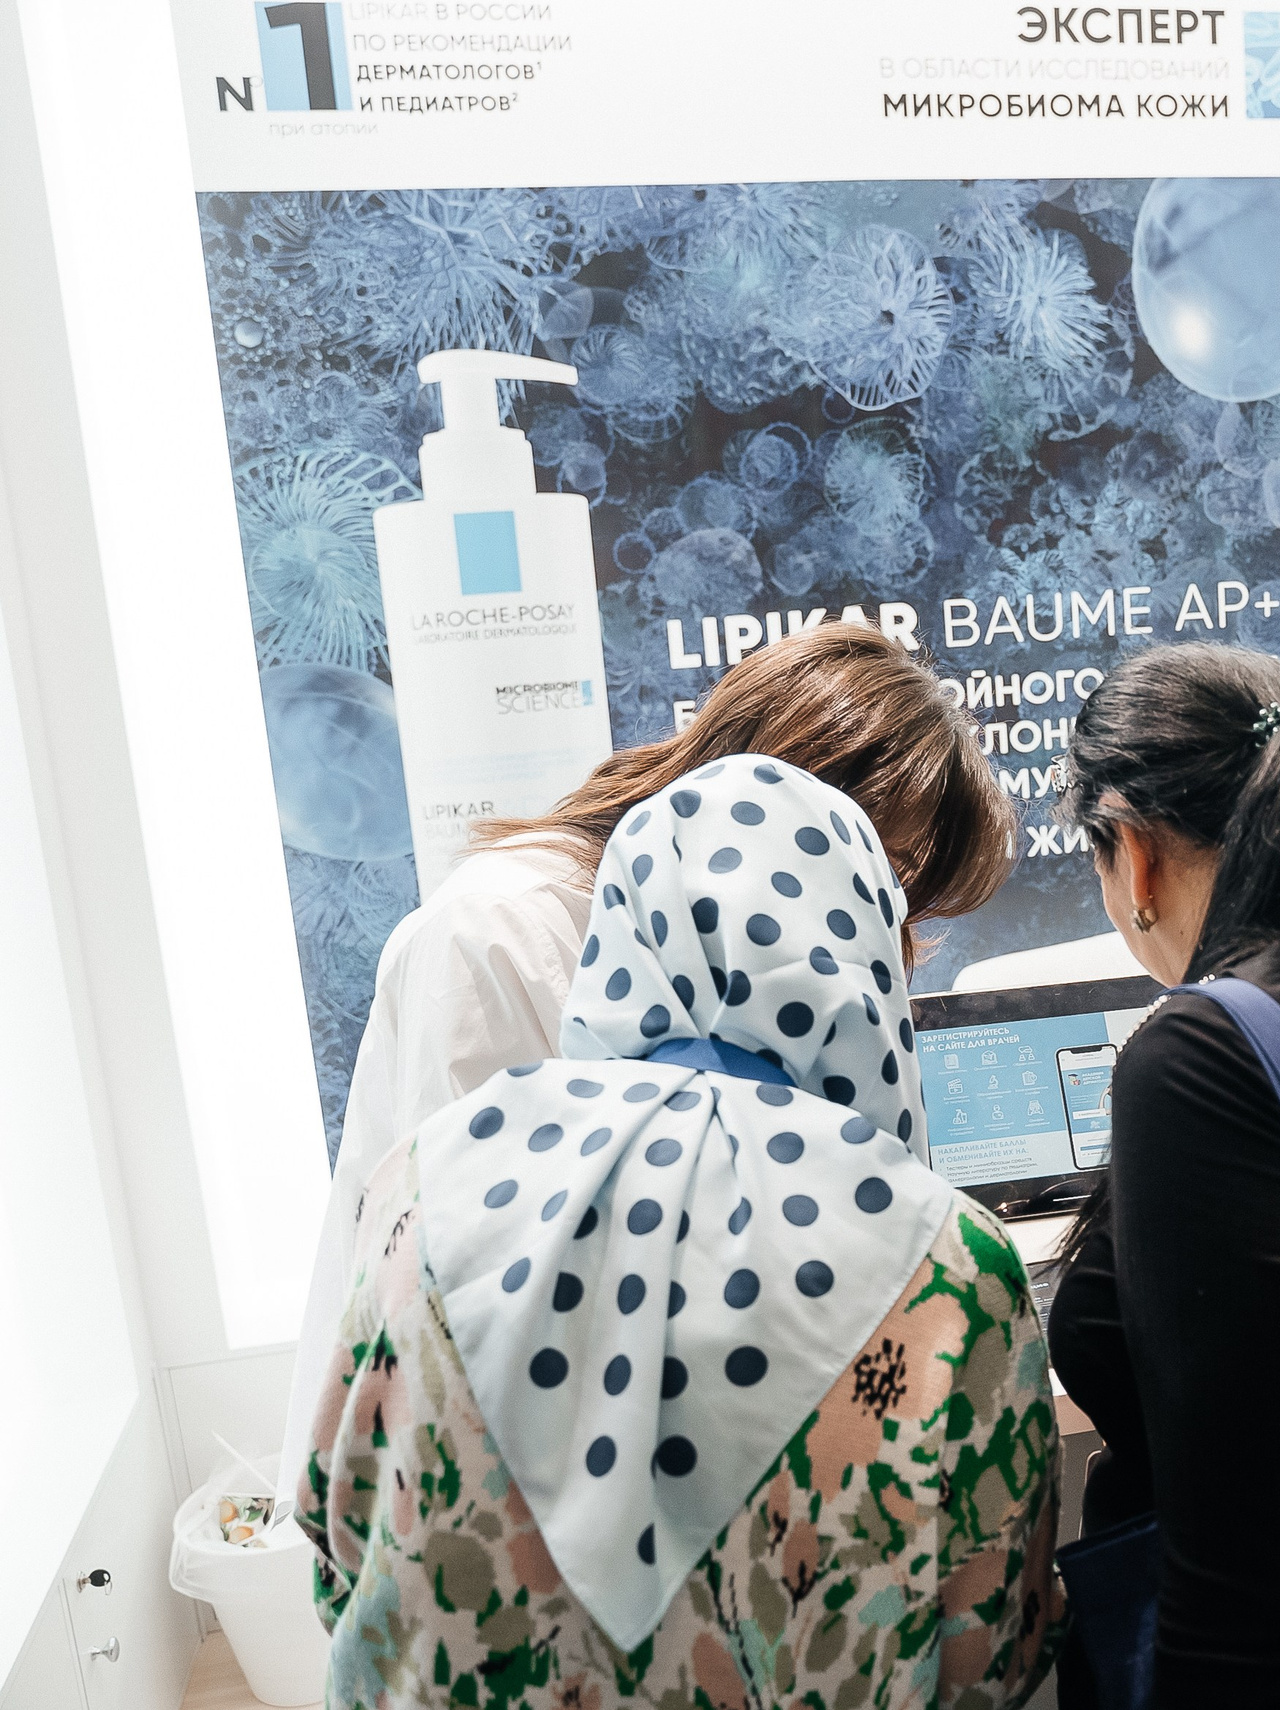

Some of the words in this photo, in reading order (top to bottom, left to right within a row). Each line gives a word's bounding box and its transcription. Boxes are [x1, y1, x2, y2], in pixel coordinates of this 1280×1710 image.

[436, 4, 449, 21] В
[456, 4, 553, 21] РОССИИ
[1017, 6, 1226, 45] ЭКСПЕРТ
[353, 34, 386, 51] ПО
[393, 34, 573, 53] РЕКОМЕНДАЦИИ
[265, 2, 338, 110] 1
[879, 58, 896, 78] В
[902, 57, 1021, 79] ОБЛАСТИ
[1028, 57, 1230, 81] ИССЛЕДОВАНИЙ
[360, 96, 373, 112] И
[883, 93, 1125, 118] МИКРОБИОМА
[1137, 94, 1229, 118] КОЖИ
[269, 123, 305, 138] при
[311, 122, 378, 136] атопии
[412, 614, 433, 630] LA
[435, 604, 575, 628] ROCHE-POSAY
[943, 586, 1153, 649] BAUME
[496, 692, 582, 715] SCIENCE
[422, 800, 496, 821] LIPIKAR
[921, 1027, 1010, 1044] ЗАРЕГИСТРИРУЙТЕСЬ
[923, 1045, 936, 1053] НА
[938, 1041, 966, 1051] САЙТЕ
[967, 1038, 986, 1048] ДЛЯ
[988, 1034, 1020, 1046] ВРАЧЕЙ
[938, 1141, 998, 1155] НАКАПЛИВАЙТЕ
[999, 1139, 1027, 1148] БАЛЛЫ
[946, 1150, 1001, 1163] ОБМЕНИВАЙТЕ
